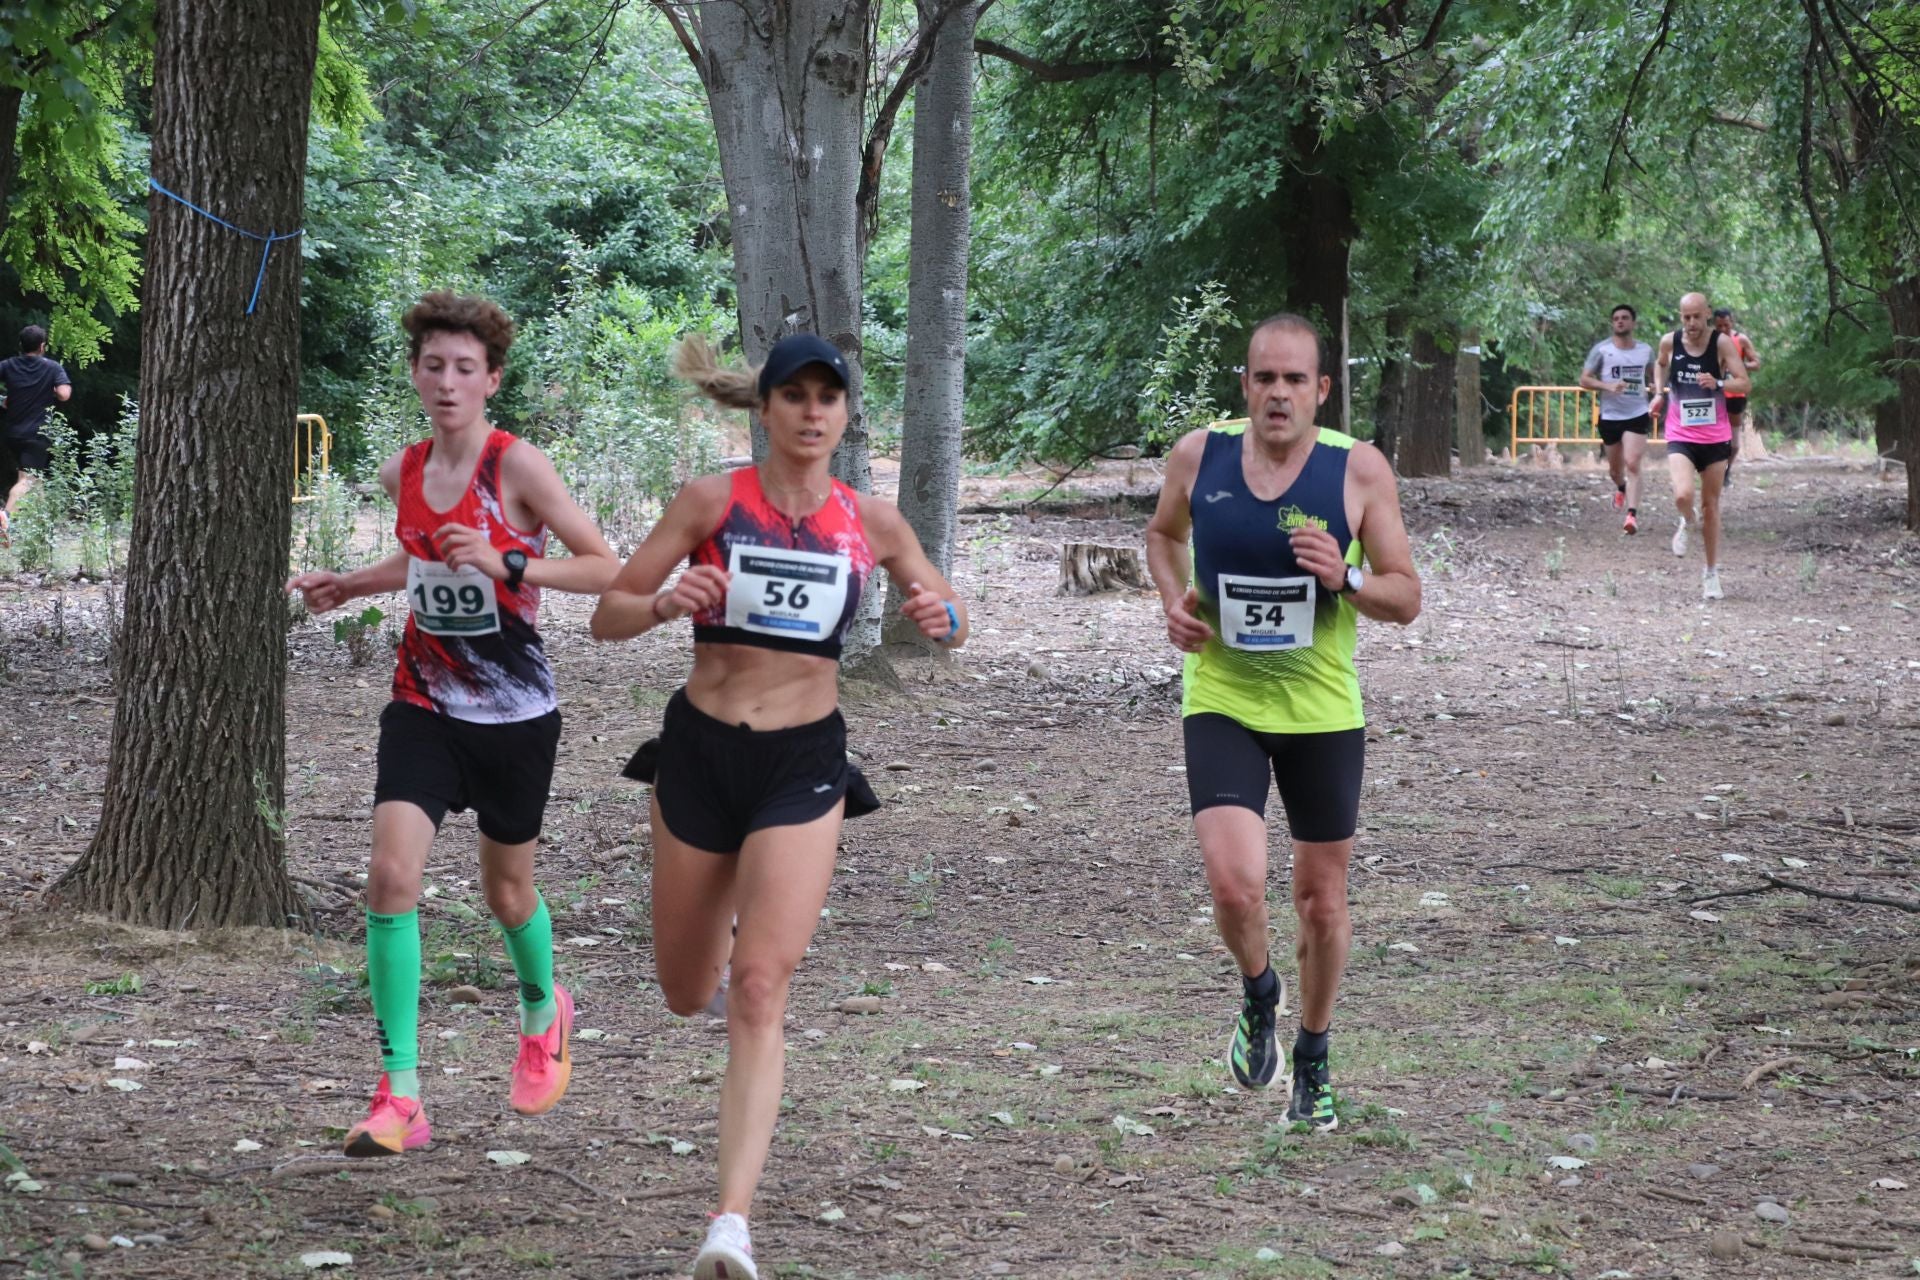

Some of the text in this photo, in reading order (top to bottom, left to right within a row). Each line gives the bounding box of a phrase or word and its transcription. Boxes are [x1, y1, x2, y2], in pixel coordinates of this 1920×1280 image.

[1687, 408, 1709, 418] 522
[775, 562, 798, 571] CIUDAD
[798, 564, 807, 572] DE
[413, 583, 485, 615] 199
[763, 580, 810, 610] 56
[1244, 604, 1285, 627] 54
